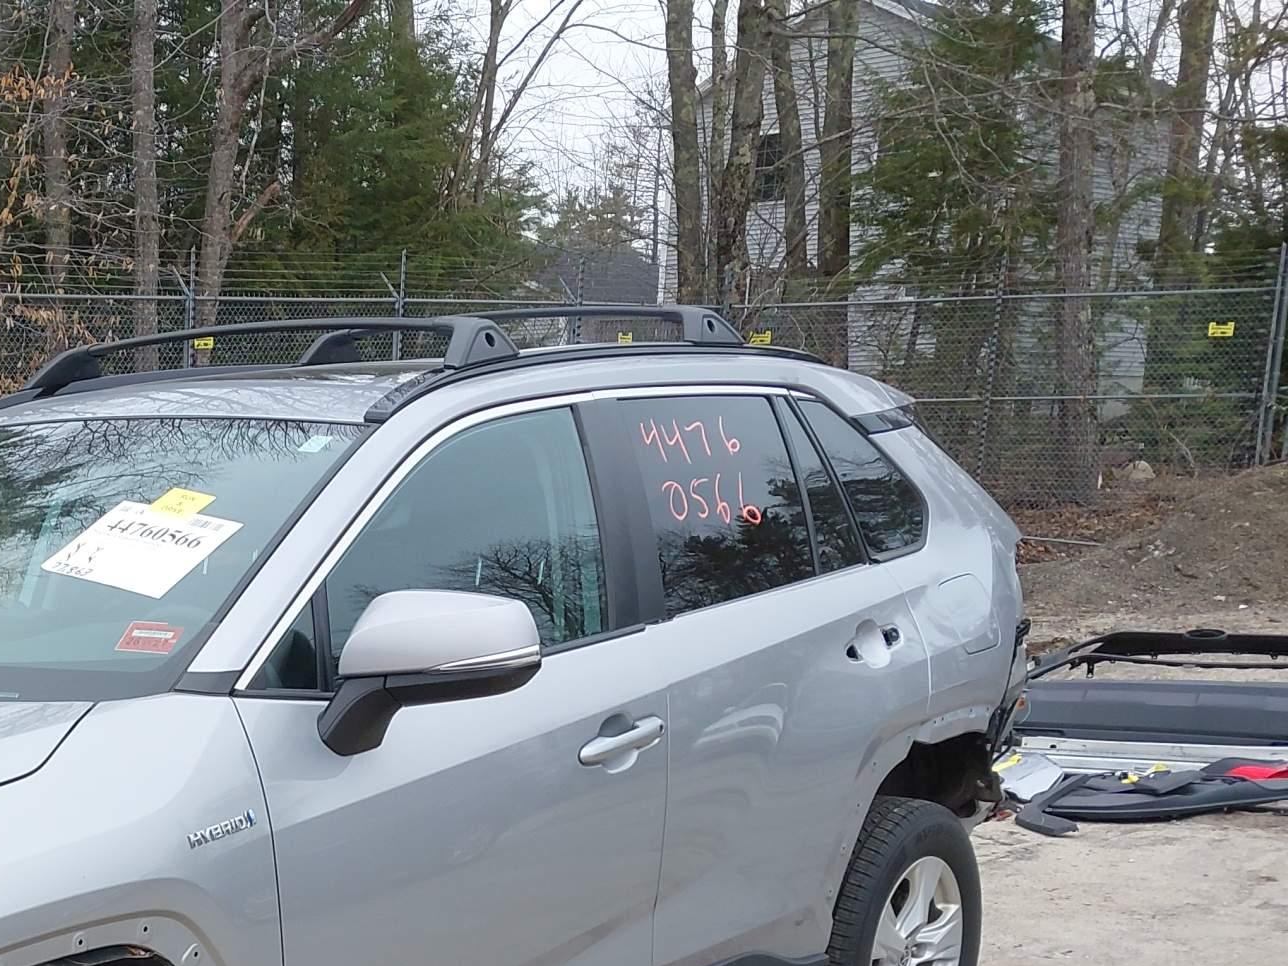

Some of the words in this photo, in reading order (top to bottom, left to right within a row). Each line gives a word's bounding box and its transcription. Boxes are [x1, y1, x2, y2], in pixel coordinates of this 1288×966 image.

[640, 415, 741, 465] 4476
[661, 471, 762, 525] 0566
[107, 518, 208, 550] 44760566
[186, 814, 249, 850] HYBRID
